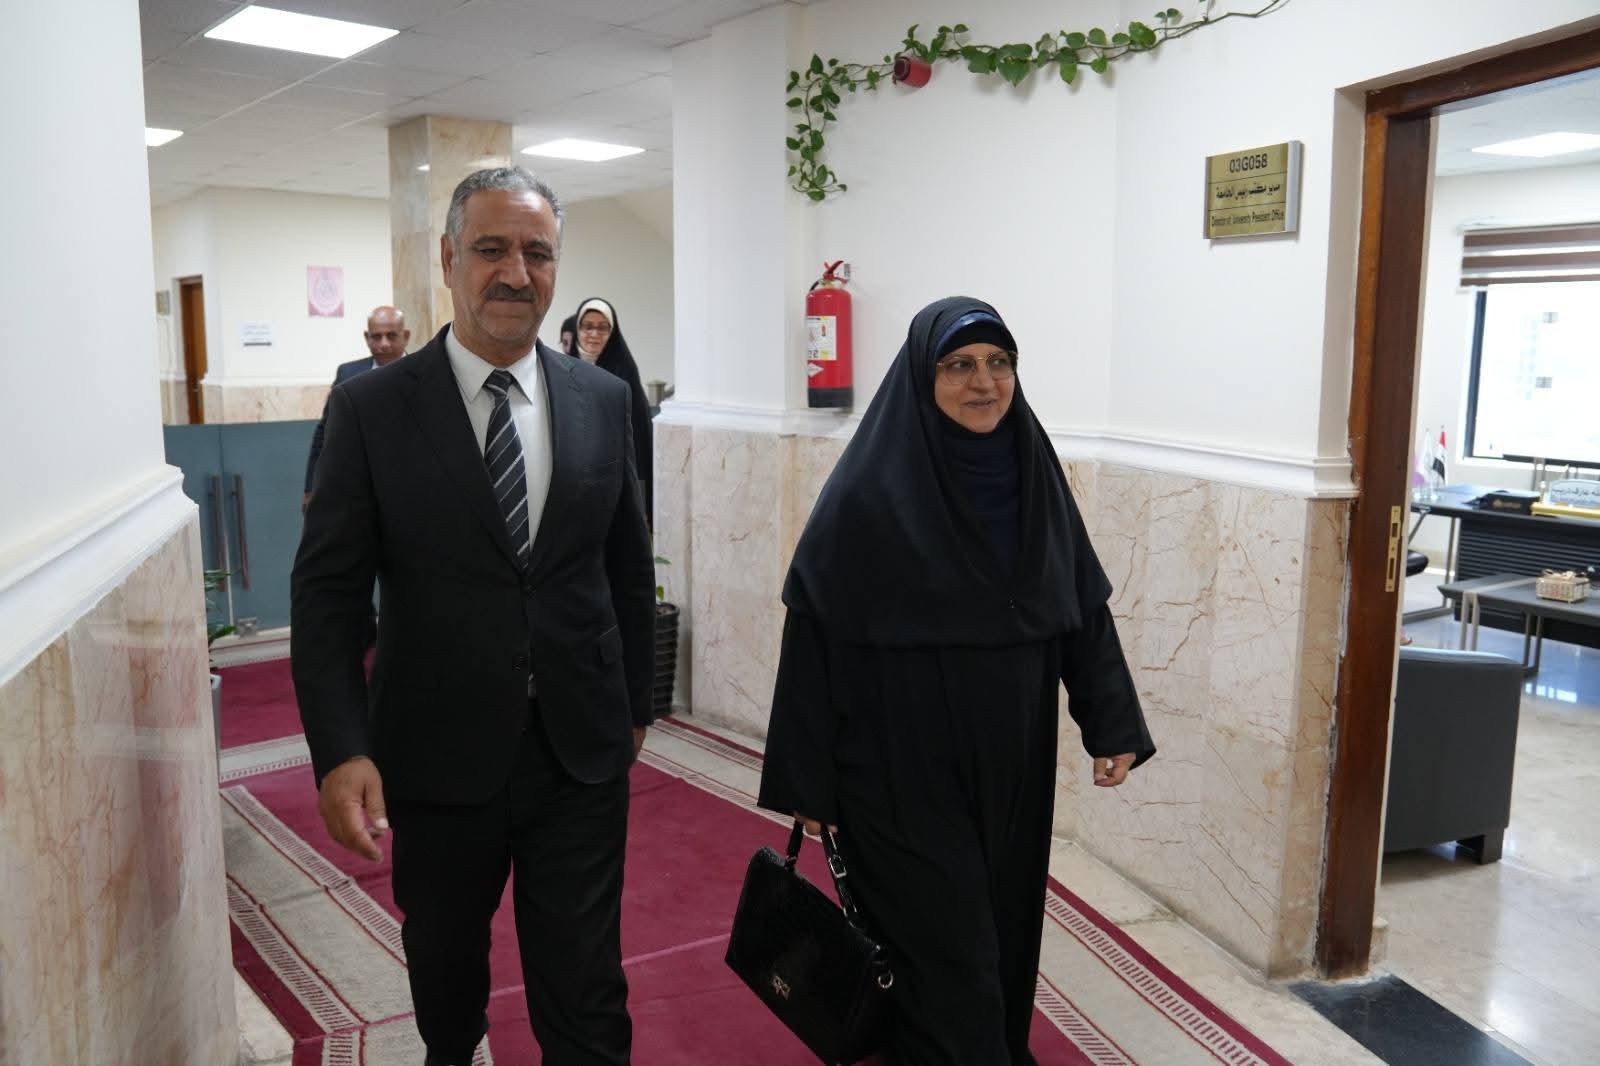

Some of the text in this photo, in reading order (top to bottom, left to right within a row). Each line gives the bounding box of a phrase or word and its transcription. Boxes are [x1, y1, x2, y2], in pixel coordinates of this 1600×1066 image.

[1229, 153, 1268, 174] 03G058
[1248, 182, 1267, 198] مكتب
[1266, 184, 1281, 197] مدير
